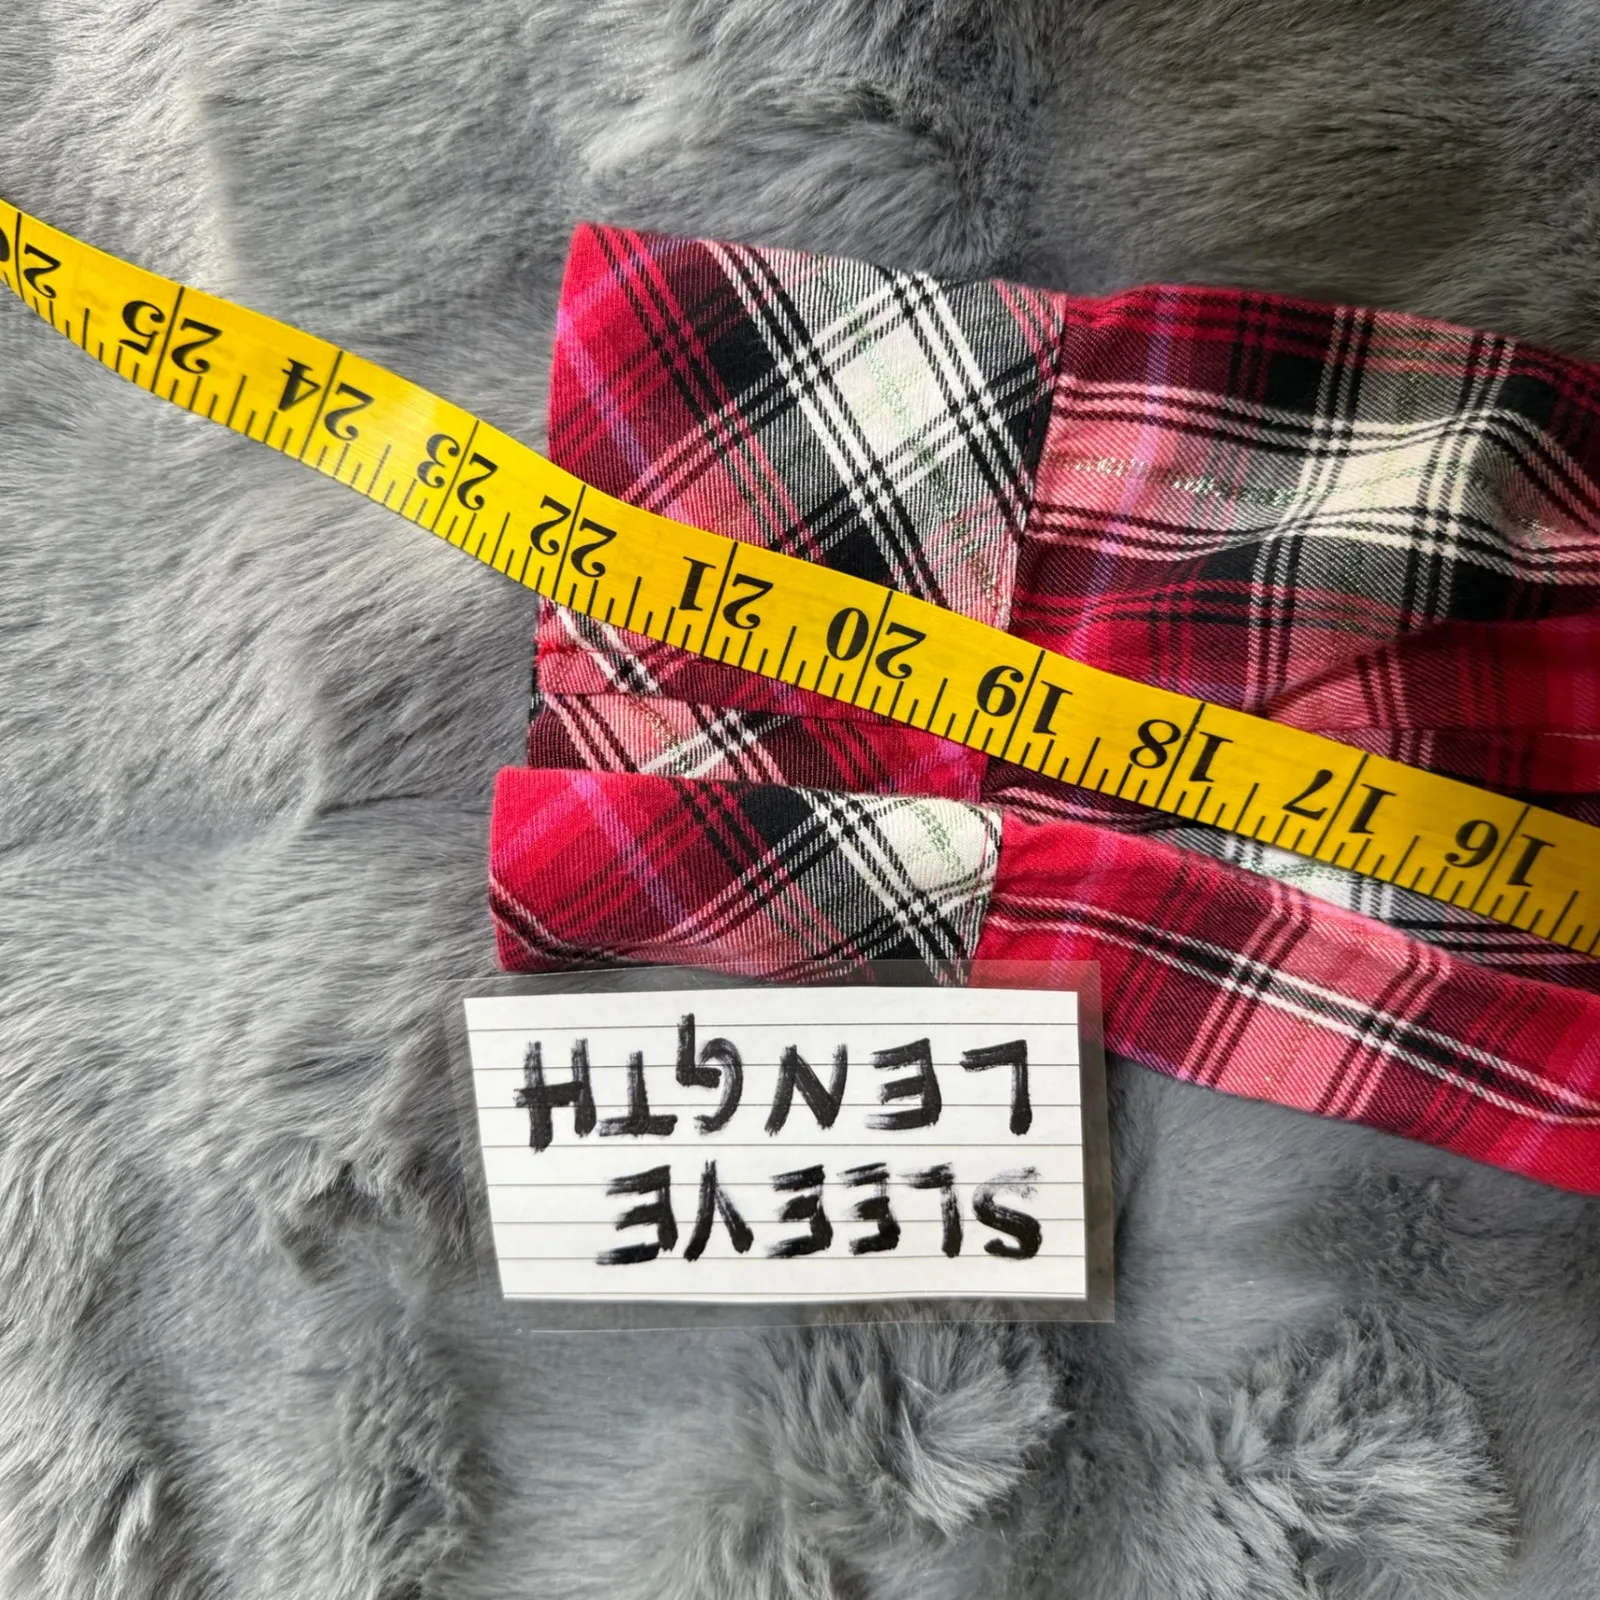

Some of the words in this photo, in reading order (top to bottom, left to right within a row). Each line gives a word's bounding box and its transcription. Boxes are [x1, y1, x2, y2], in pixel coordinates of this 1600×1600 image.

[0, 226, 62, 299] 2
[119, 300, 223, 374] 25
[276, 357, 374, 441] 24
[416, 433, 498, 511] 23
[530, 495, 617, 577] 22
[678, 556, 774, 629] 21
[826, 607, 926, 680] 20
[976, 665, 1073, 735] 19
[1129, 719, 1233, 783] 18
[1282, 769, 1396, 834] 17
[1444, 820, 1555, 887] 16
[513, 1013, 1032, 1152] LENGTH
[596, 1159, 1042, 1264] SLEEVE
